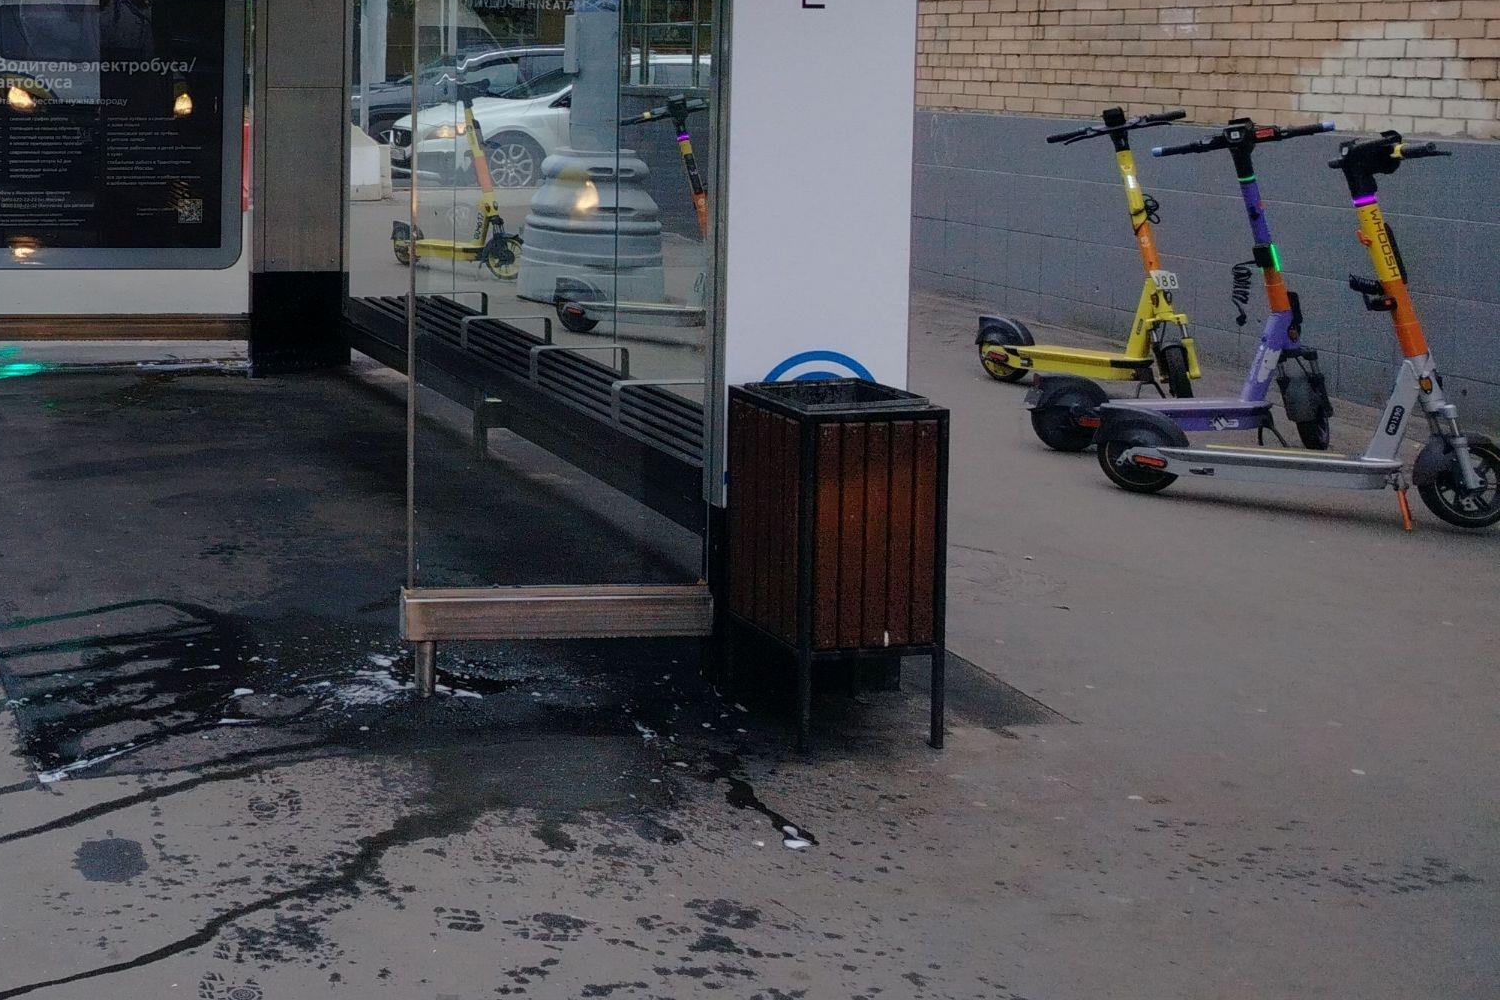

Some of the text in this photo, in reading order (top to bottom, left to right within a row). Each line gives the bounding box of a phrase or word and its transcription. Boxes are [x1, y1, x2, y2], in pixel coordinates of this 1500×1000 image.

[82, 57, 197, 75] электробуса/
[65, 98, 94, 106] нужна
[97, 98, 127, 106] городу
[1370, 209, 1400, 278] WHOOSH
